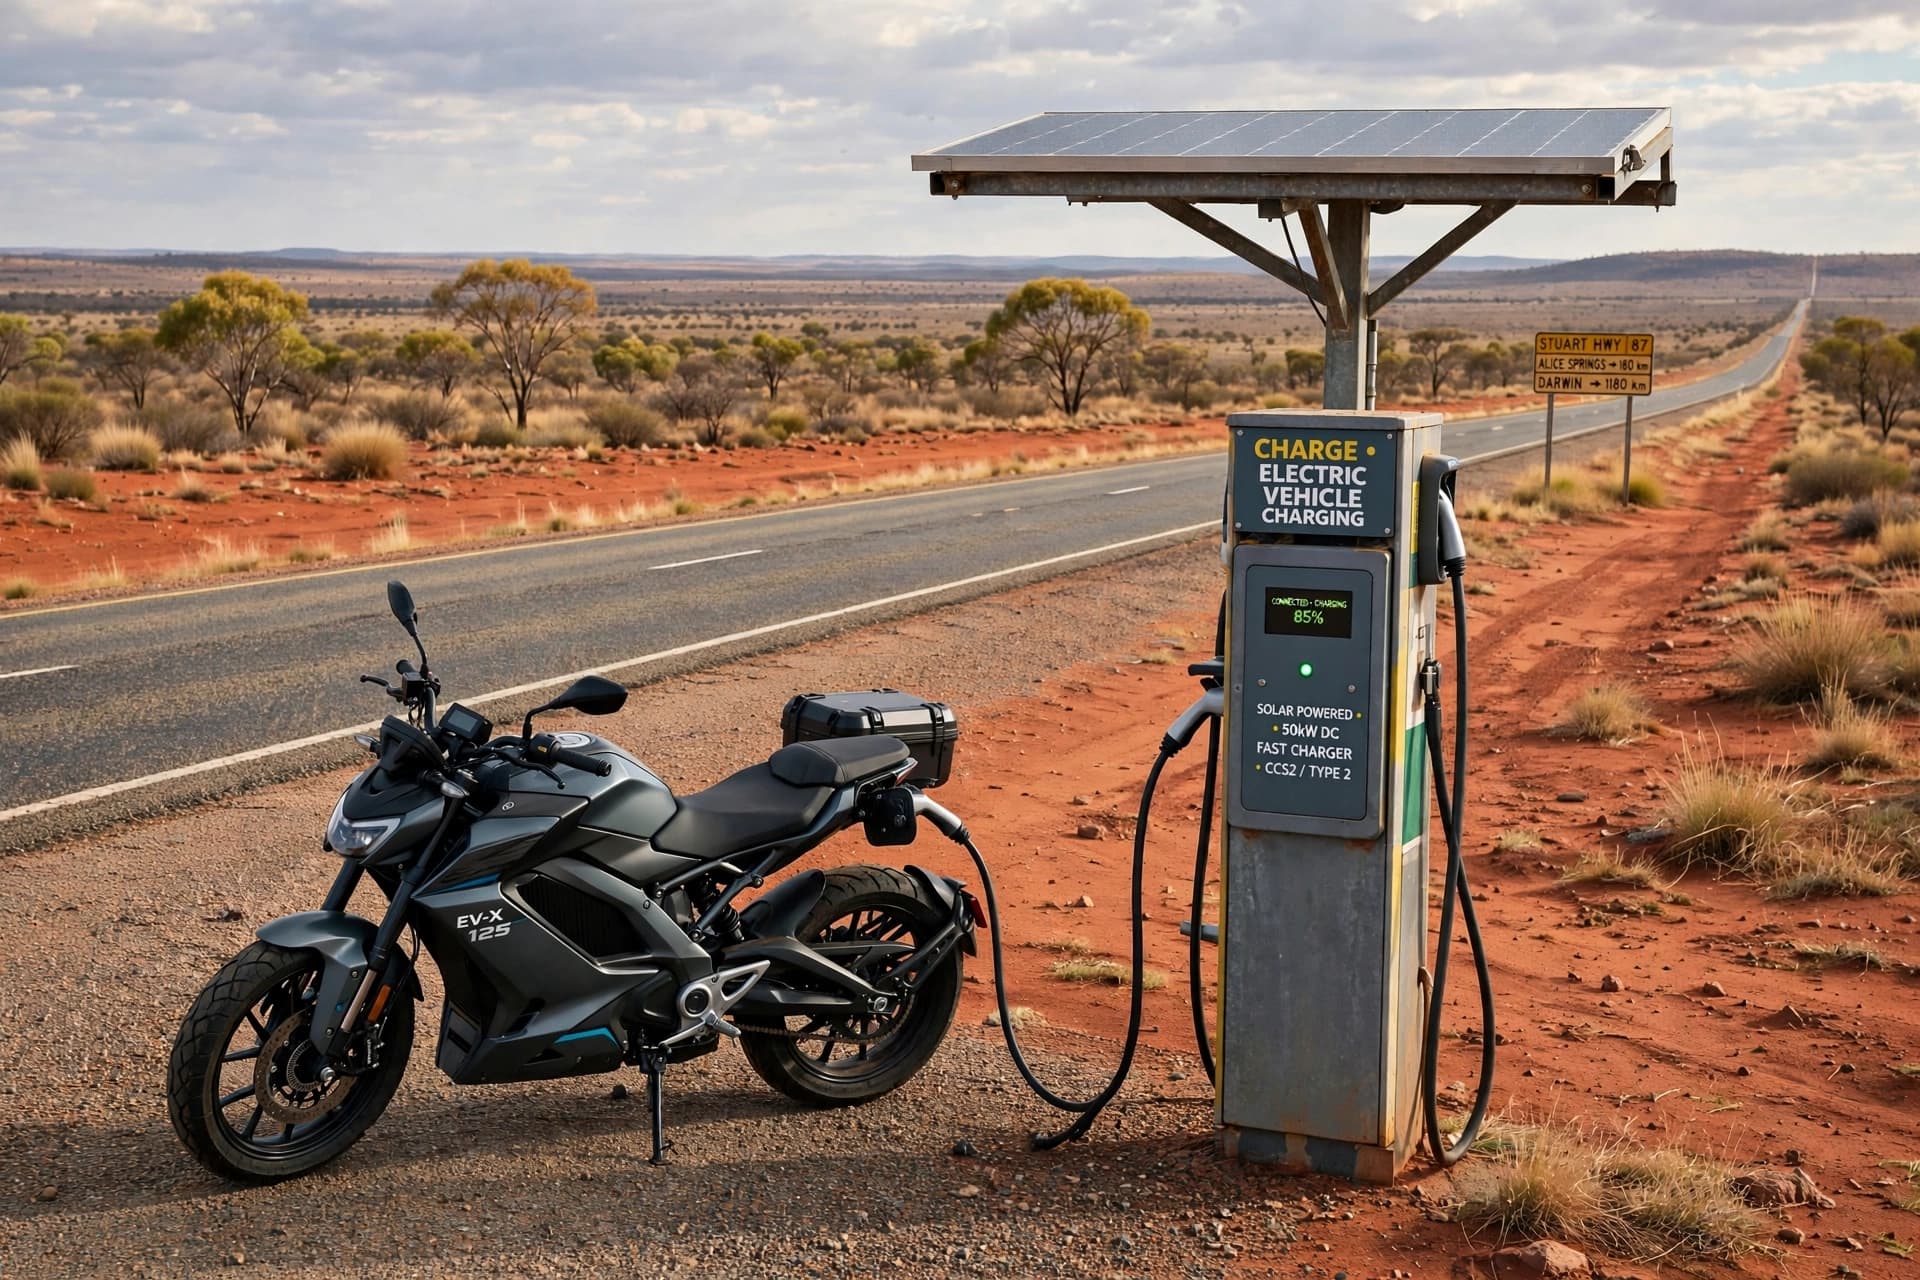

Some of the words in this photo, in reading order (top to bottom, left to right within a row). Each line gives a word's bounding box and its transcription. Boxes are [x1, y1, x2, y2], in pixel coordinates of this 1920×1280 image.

[1540, 337, 1588, 350] STUART
[1593, 338, 1622, 351] HWY
[1631, 339, 1648, 352] 87
[1538, 358, 1565, 370] ALICE
[1568, 358, 1606, 370] SPRINGS
[1637, 361, 1649, 370] km
[1538, 376, 1582, 389] DARWIN
[1605, 378, 1627, 390] 1180
[1631, 379, 1646, 390] km
[1254, 438, 1358, 461] CHARGE
[1259, 463, 1367, 486] ELECTRIC
[1263, 486, 1362, 508] VEHICLE
[1261, 507, 1365, 527] CHARGING
[1293, 609, 1324, 624] 85%
[1257, 703, 1294, 716] SOLAR
[1296, 706, 1353, 720] POWERED
[1282, 723, 1318, 738] 50kW
[1320, 726, 1340, 739] DC
[1256, 741, 1287, 755] FAST
[1290, 744, 1352, 760] CHARGER
[1265, 762, 1296, 776] CCS2
[1299, 764, 1306, 778] /
[1308, 765, 1340, 780] TYPE
[1343, 768, 1351, 780] 2
[457, 907, 503, 929] EV-X
[468, 921, 512, 943] 125
